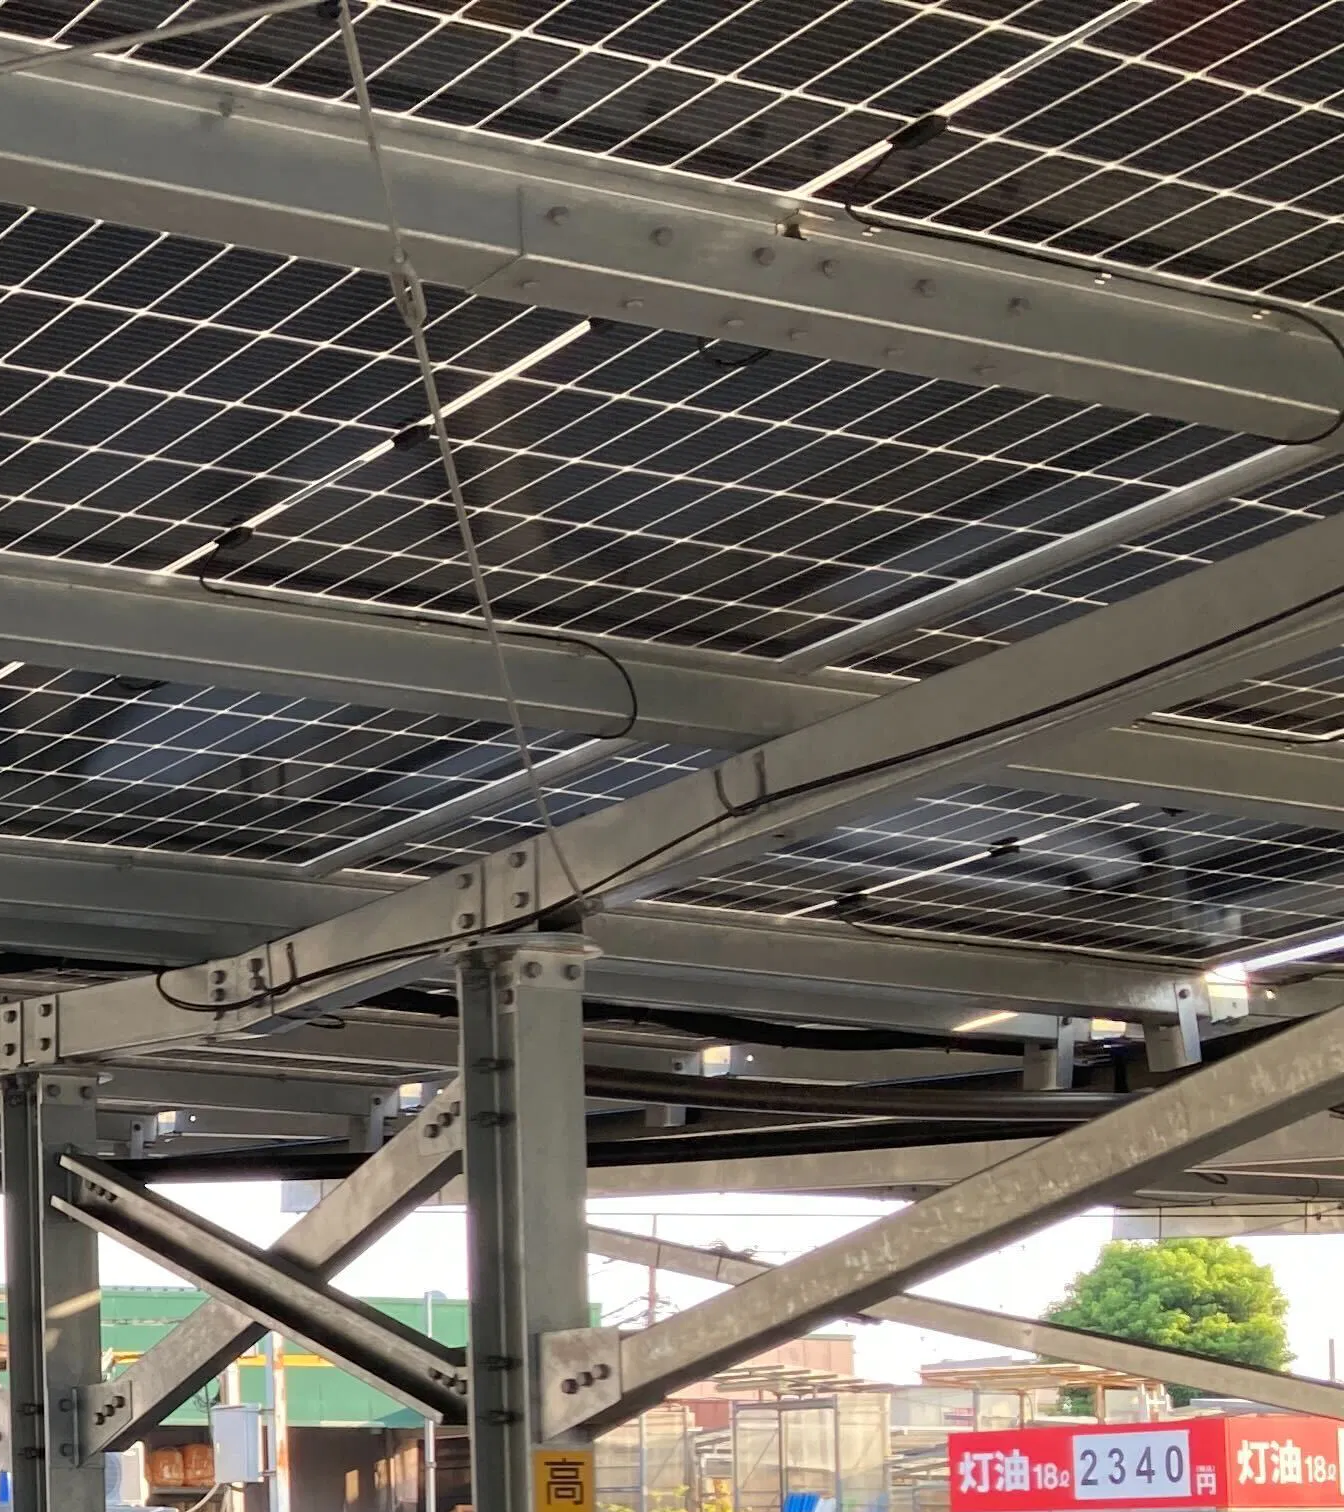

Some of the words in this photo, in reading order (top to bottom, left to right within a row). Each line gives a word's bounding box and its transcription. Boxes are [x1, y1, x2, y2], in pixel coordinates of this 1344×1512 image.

[958, 1448, 1030, 1494] 灯油
[1079, 1444, 1185, 1487] 2340
[1196, 1472, 1217, 1496] 円
[1237, 1439, 1303, 1485] 灯油
